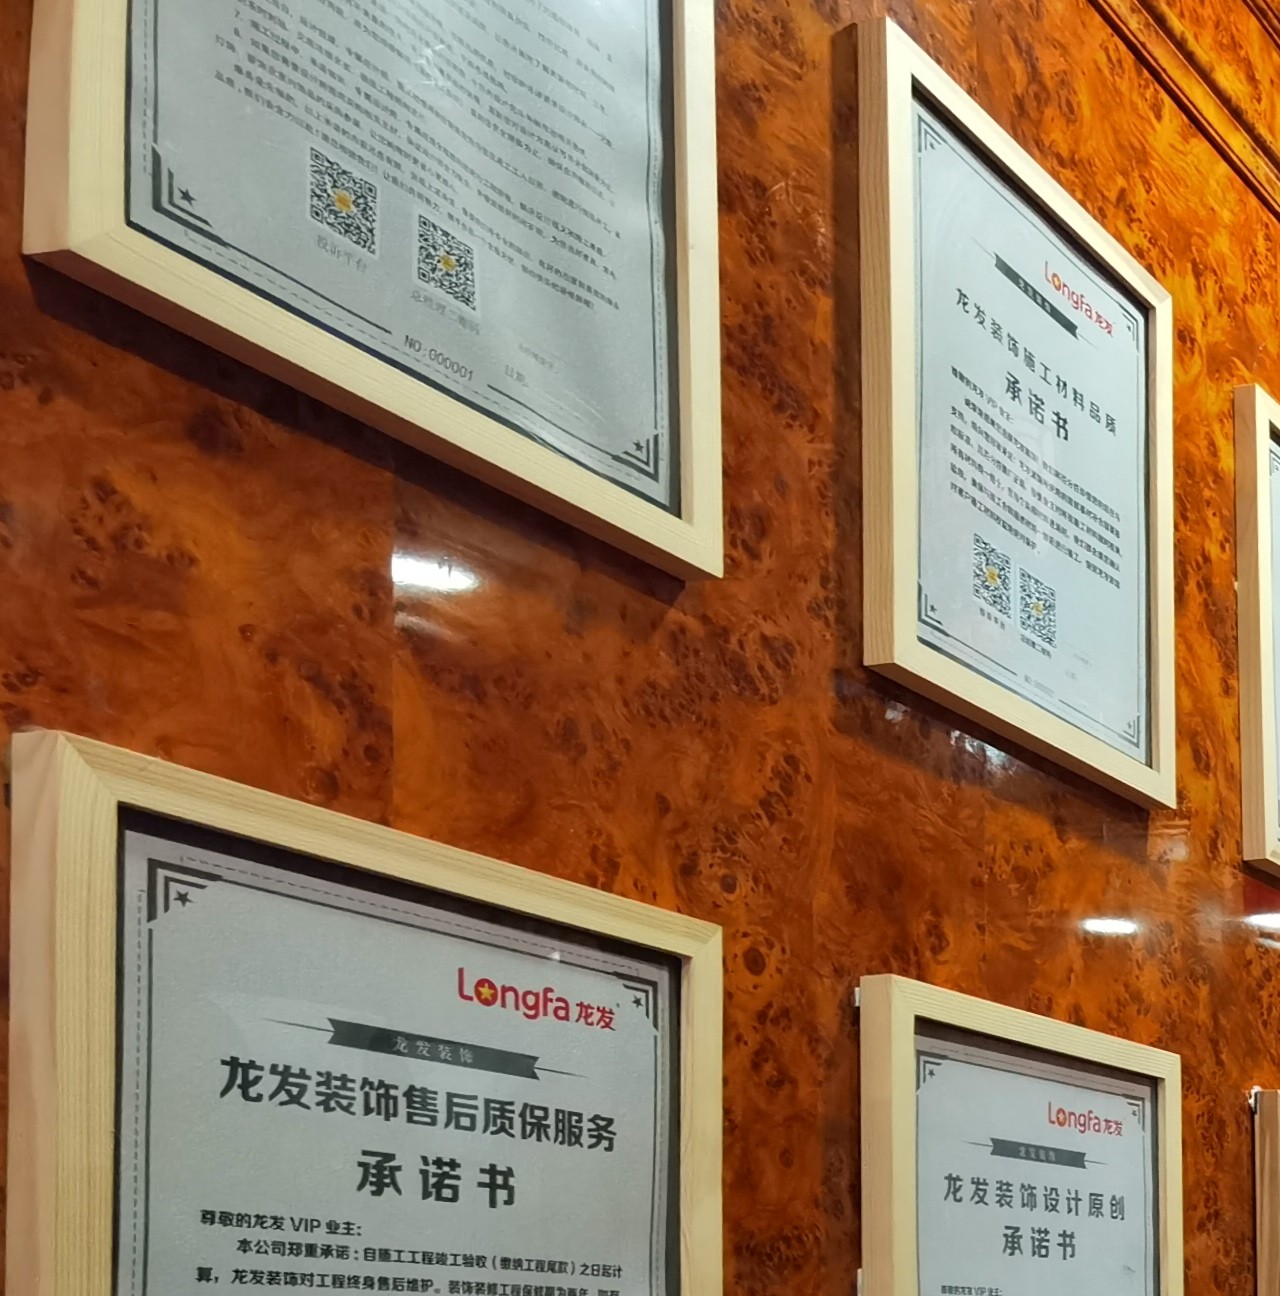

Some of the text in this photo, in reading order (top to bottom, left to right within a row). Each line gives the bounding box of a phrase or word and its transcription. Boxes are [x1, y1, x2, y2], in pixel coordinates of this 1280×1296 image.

[1044, 261, 1092, 320] Longfa
[1005, 371, 1069, 441] 承诺书
[457, 966, 618, 1031] Longfa 龙发
[218, 1056, 618, 1152] 龙发装饰售后质保服务
[1047, 1101, 1101, 1134] Longfa
[356, 1150, 516, 1208] 承诺书
[943, 1172, 1126, 1221] 龙发装饰设计原创
[290, 1216, 321, 1233] VIP
[1002, 1224, 1077, 1261] 承诺书
